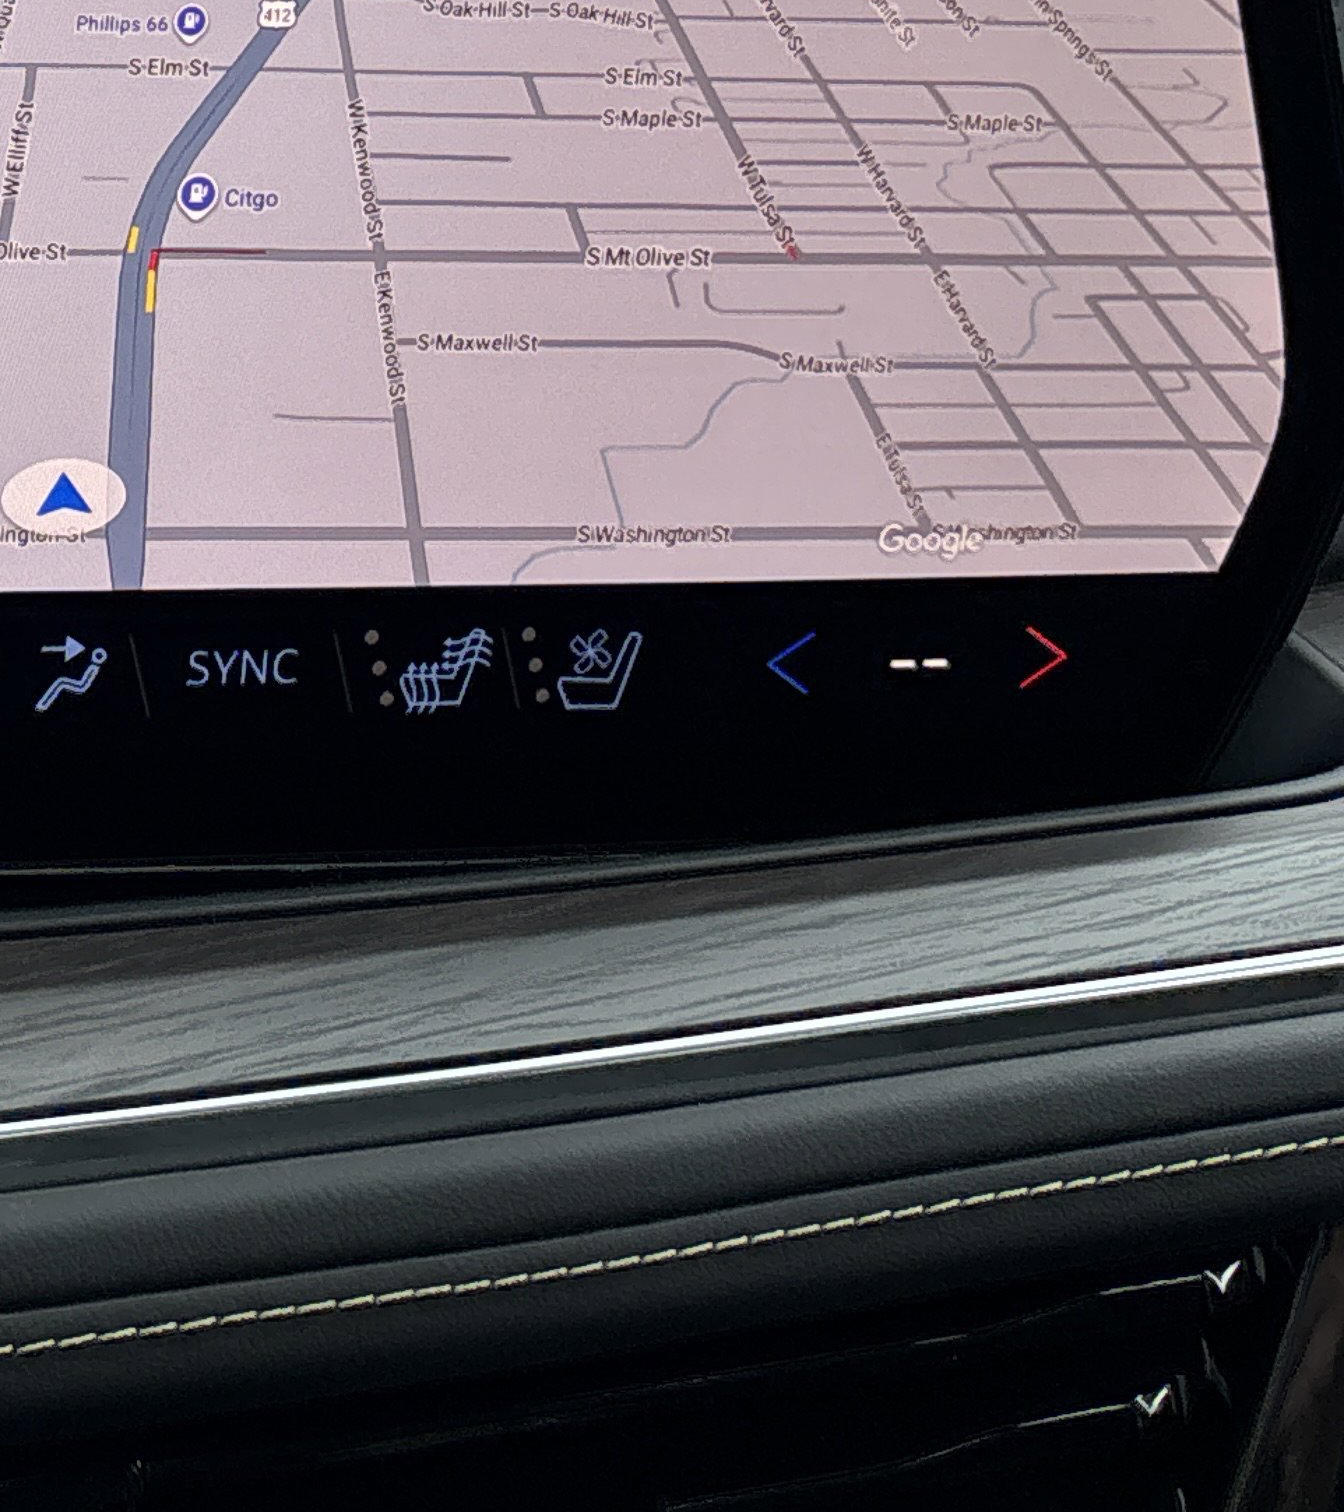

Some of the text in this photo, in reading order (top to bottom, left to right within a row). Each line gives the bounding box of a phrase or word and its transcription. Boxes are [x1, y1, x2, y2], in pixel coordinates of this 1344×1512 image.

[77, 15, 168, 34] Phillips 66
[263, 7, 291, 23] 412
[898, 28, 916, 48] St
[962, 18, 981, 38] St
[786, 37, 806, 57] St
[1047, 8, 1095, 63] Springs
[1093, 59, 1112, 82] St
[603, 111, 701, 129] S Maple St
[1, 102, 35, 197] W Elliff St
[225, 190, 278, 212] Citgo
[737, 157, 796, 248] W Tulsa St
[375, 272, 405, 405] E Kenwood St
[417, 335, 537, 352] S Maxwell St
[879, 524, 983, 560] Google
[186, 648, 298, 687] SYNC
